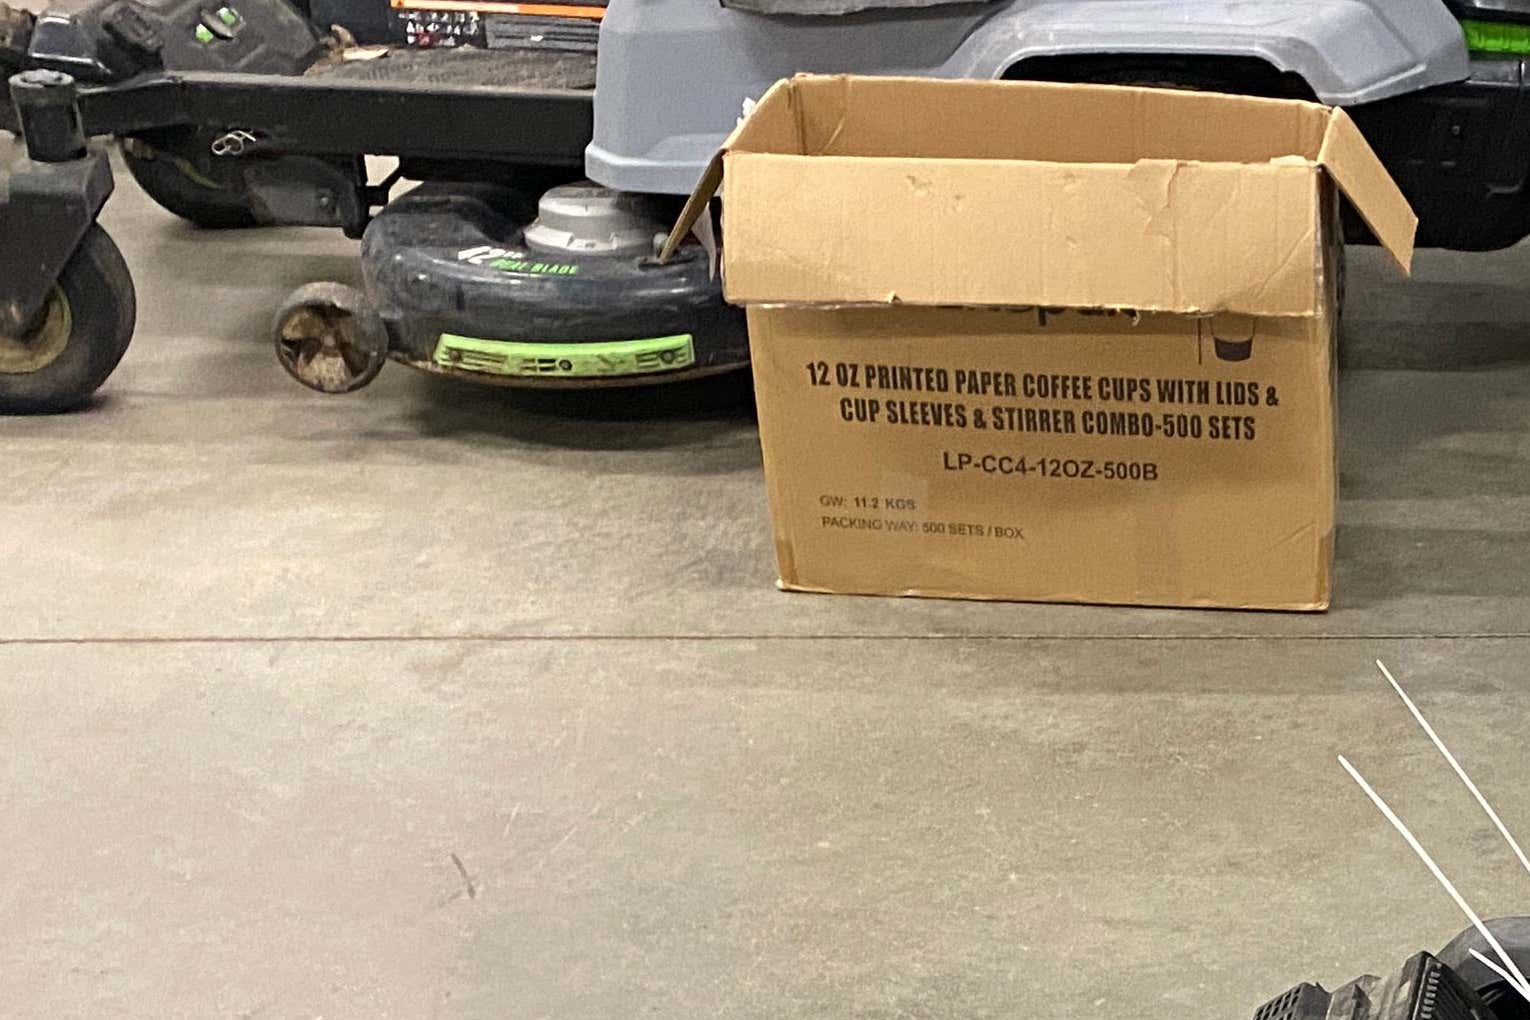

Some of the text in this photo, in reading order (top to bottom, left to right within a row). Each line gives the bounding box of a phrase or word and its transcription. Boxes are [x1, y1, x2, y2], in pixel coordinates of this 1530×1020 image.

[530, 262, 579, 275] BLADE
[806, 361, 1280, 407] 12 OZ PRINTED PAPER COFFEE CUPS WITH LIDS &
[840, 397, 1256, 440] CUP SLEEVES & STIRRER COMBO-500 SETS
[819, 494, 916, 511] GW: 11.2 KGS
[821, 516, 882, 530] PACKING
[922, 521, 945, 534] 500
